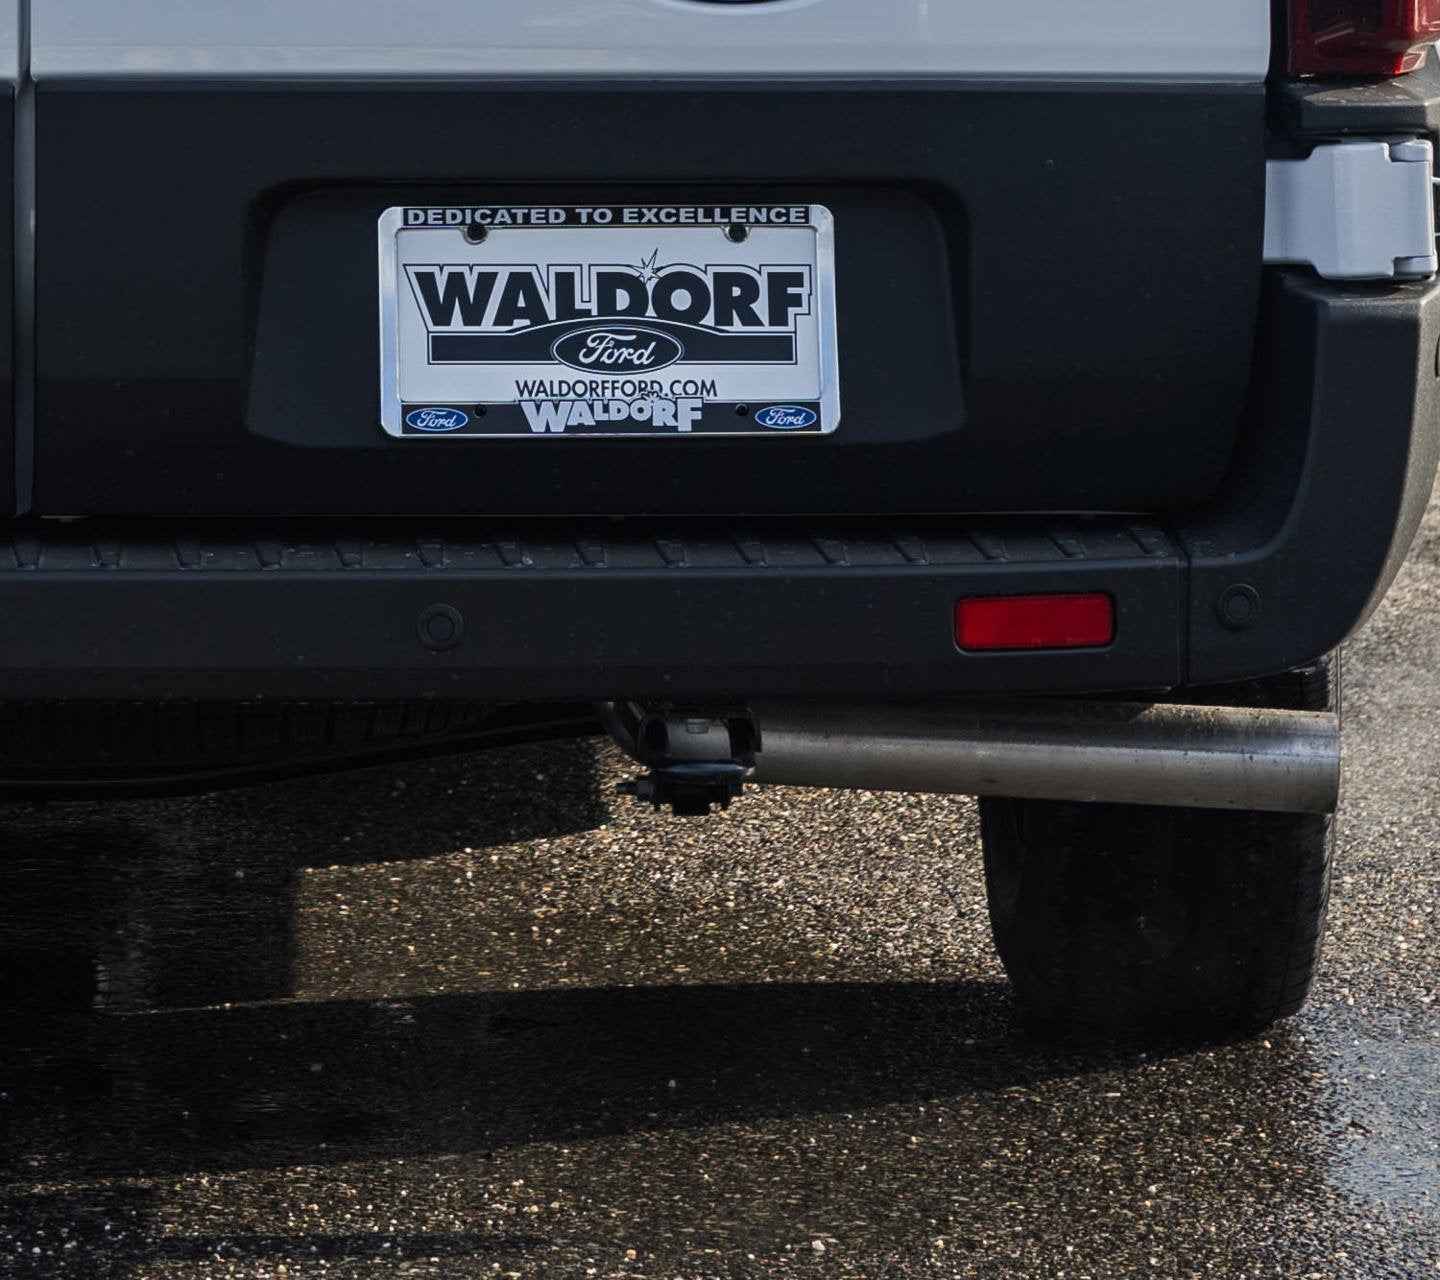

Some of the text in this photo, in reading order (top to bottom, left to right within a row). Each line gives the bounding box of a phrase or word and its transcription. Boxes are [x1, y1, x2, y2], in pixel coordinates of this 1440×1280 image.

[407, 206, 806, 225] DEDICATED TO EXCELLENCE
[407, 266, 811, 328] WALDORF
[578, 332, 657, 365] Ford
[515, 379, 718, 398] WALDORFFORD.COM
[417, 410, 458, 427] Ford
[520, 397, 704, 433] WALDORF
[765, 408, 806, 425] Ford
